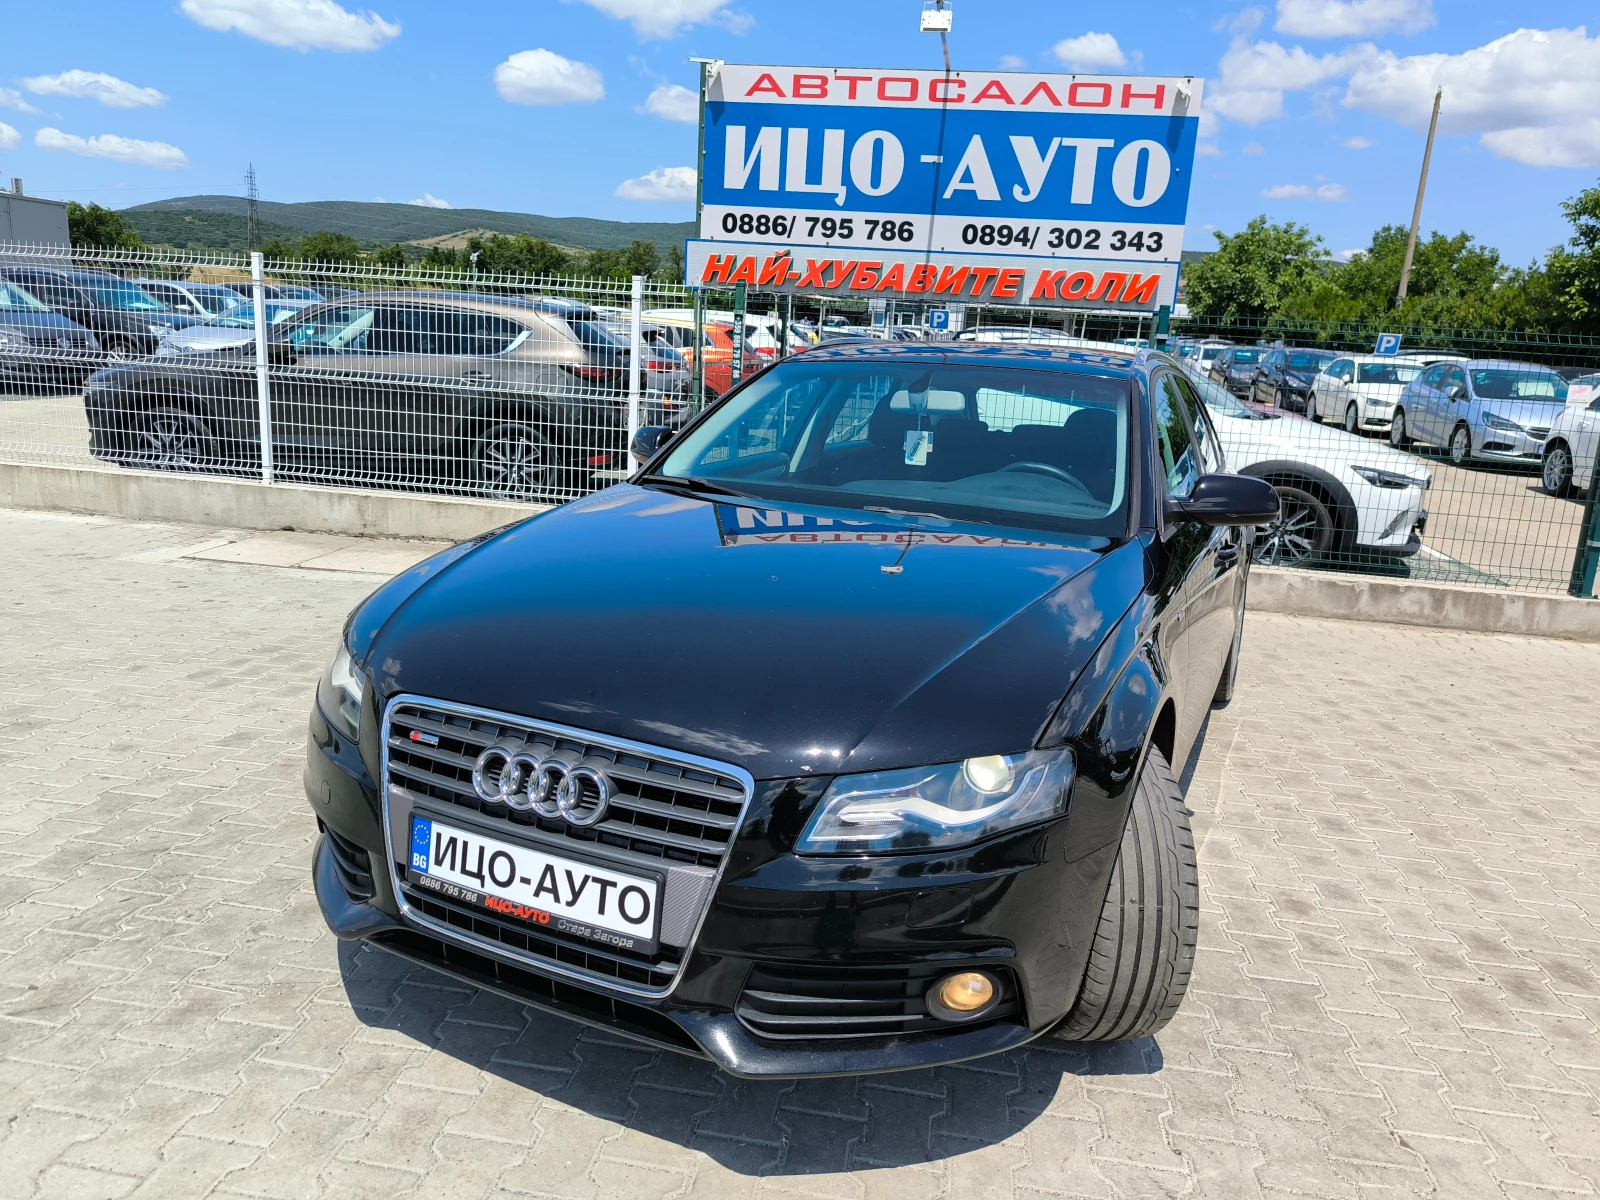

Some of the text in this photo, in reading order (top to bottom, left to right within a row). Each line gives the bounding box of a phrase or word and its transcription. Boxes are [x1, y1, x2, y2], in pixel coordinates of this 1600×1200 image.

[744, 73, 1166, 110] АВТОСАЛОН
[722, 213, 1163, 252] 0886/ 795 786 0894/ 302 343
[700, 249, 1162, 304] НАЙ-ХУБАВИТЕ КОЛИ
[932, 311, 946, 328] P
[1380, 336, 1396, 352] P
[412, 852, 427, 869] BG
[433, 831, 651, 925] ИЦО-АУТО
[420, 876, 634, 949] 0886 795 786 ИЦО-АУТО Стара Загора
